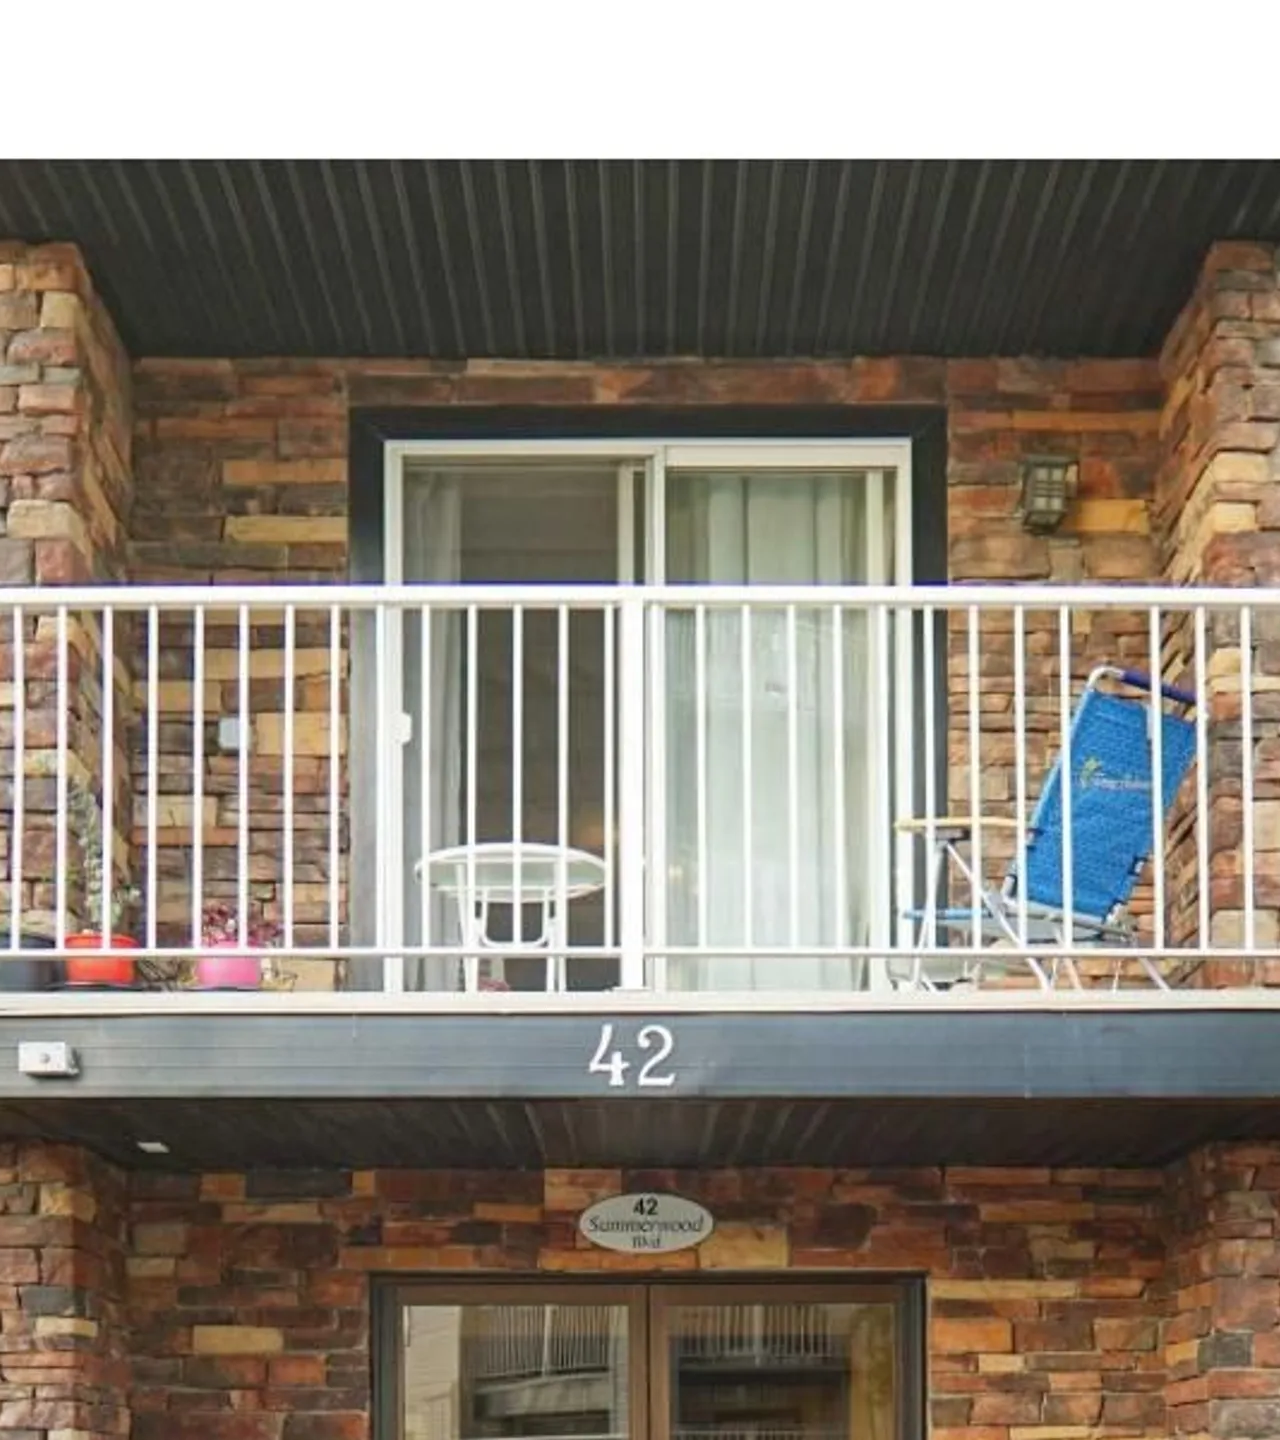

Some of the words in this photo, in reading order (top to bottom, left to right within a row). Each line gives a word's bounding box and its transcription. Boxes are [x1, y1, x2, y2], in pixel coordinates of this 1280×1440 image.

[588, 1023, 676, 1087] 42
[633, 1197, 659, 1216] 42
[588, 1214, 705, 1233] Summerwood
